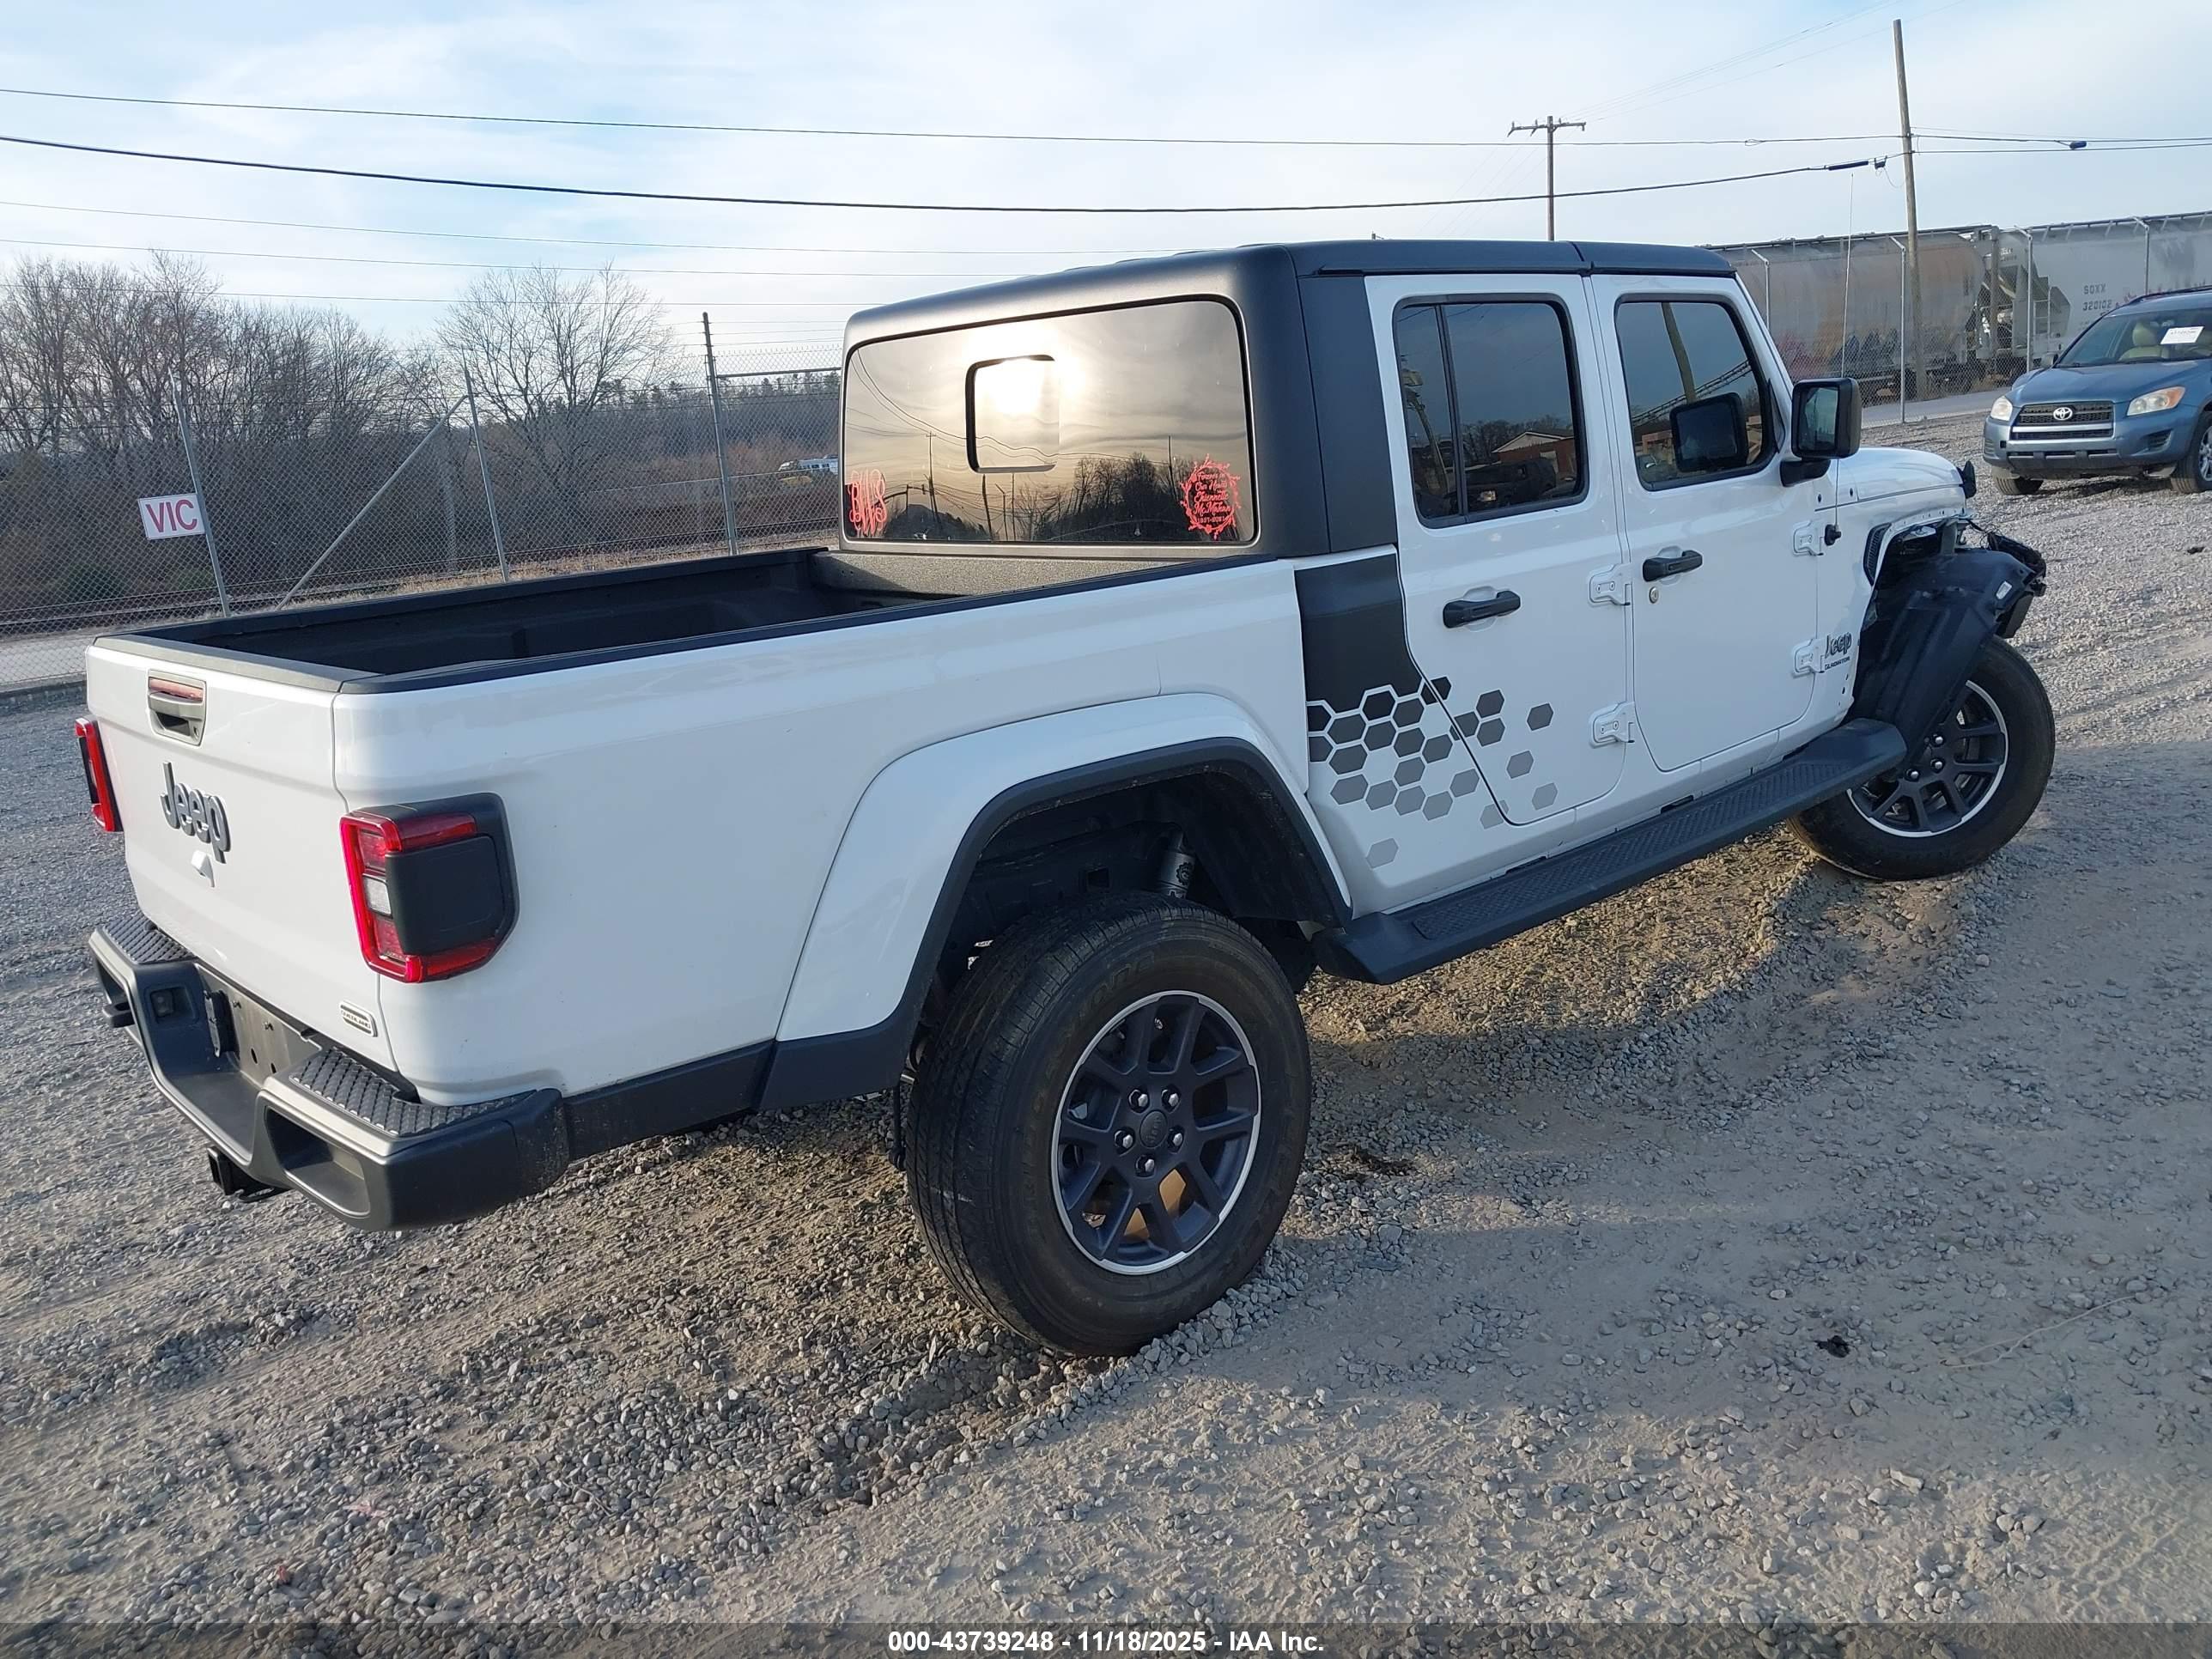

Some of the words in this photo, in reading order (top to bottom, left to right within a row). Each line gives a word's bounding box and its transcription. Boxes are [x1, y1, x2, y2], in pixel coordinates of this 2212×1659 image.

[145, 499, 198, 532] VIC
[1825, 632, 1852, 659] Jeep
[160, 762, 232, 864] Jeep
